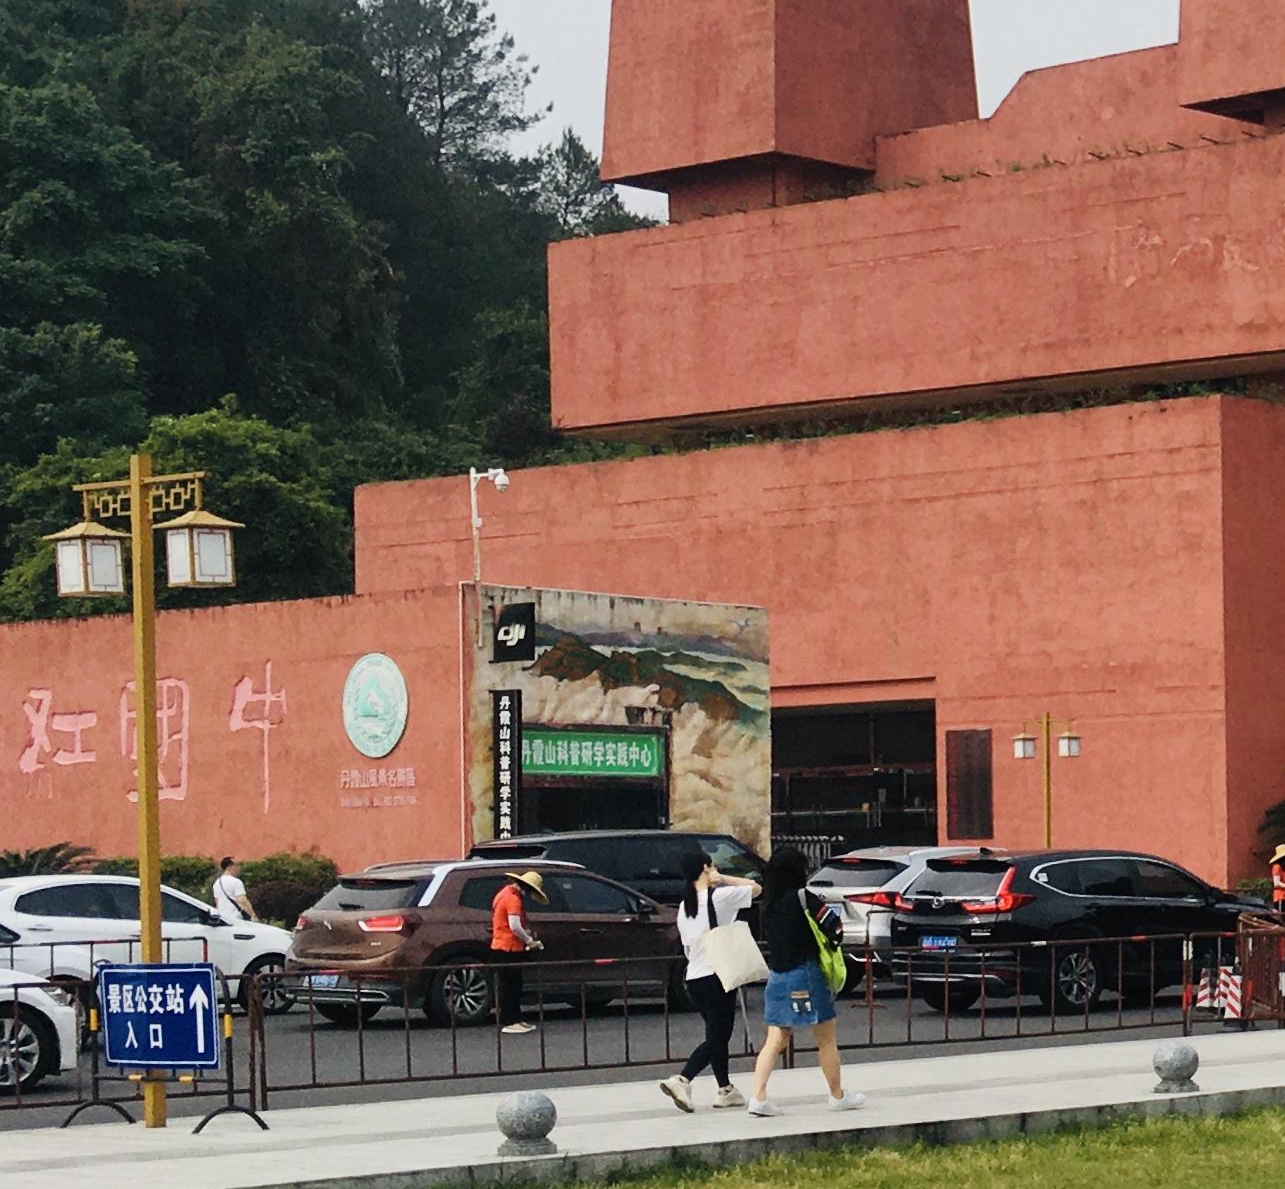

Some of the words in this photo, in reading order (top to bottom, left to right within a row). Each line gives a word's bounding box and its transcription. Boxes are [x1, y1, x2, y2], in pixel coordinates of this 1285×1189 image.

[107, 983, 184, 1014] 景区公交站
[125, 1020, 163, 1049] 入口
